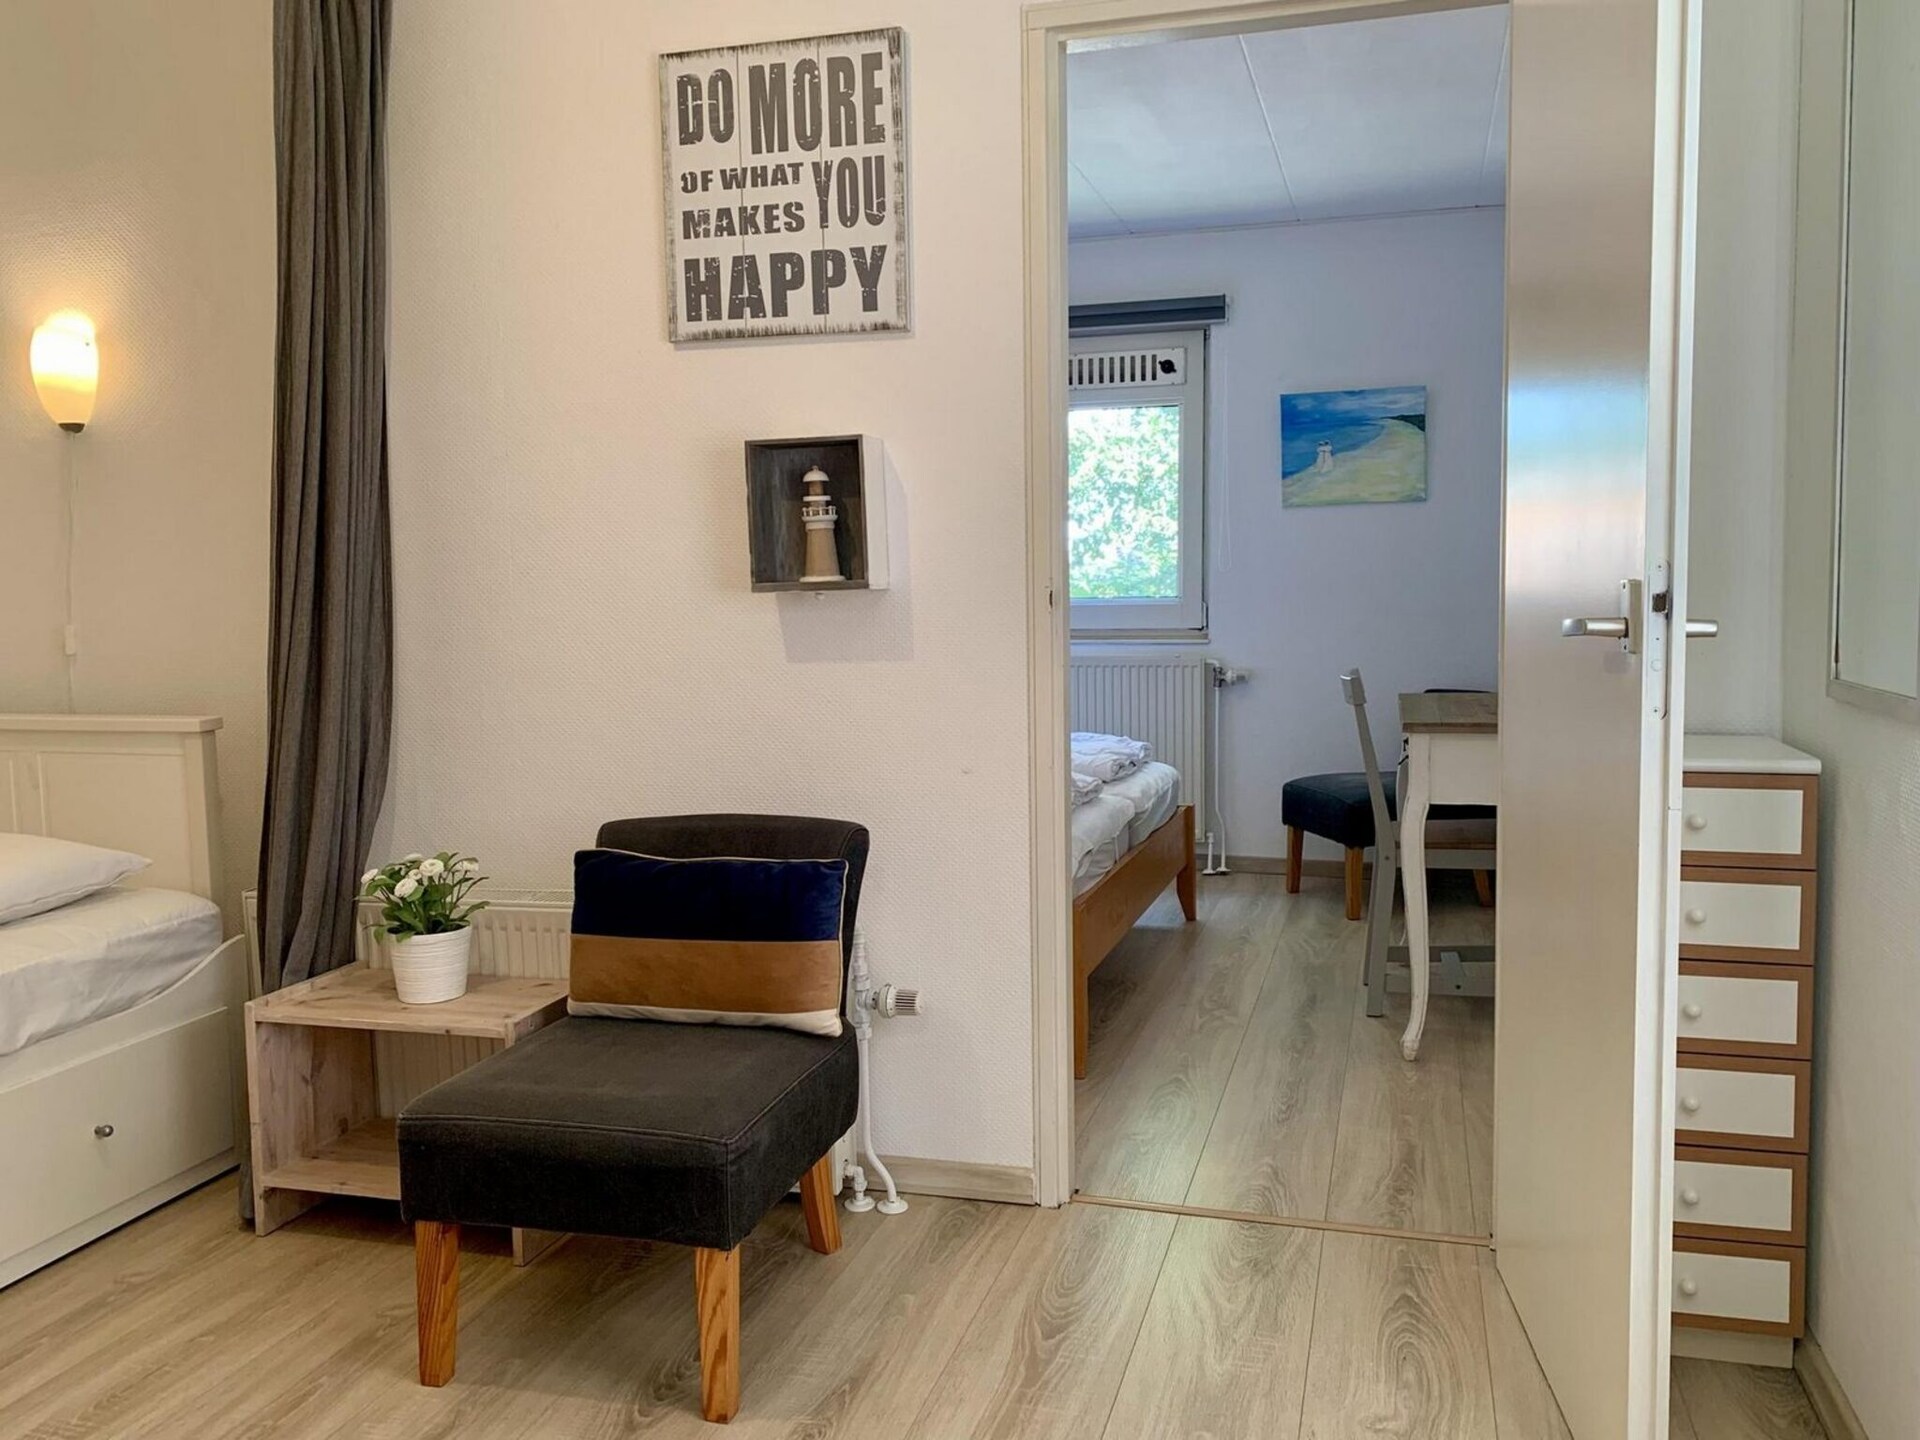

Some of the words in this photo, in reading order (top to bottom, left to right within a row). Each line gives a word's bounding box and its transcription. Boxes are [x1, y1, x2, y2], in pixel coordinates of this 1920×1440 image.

[677, 68, 734, 146] DO
[748, 52, 886, 155] MORE
[680, 170, 713, 194] OF
[719, 162, 804, 190] WHAT
[811, 155, 886, 229] YOU
[682, 201, 805, 240] MAKES
[684, 245, 887, 322] HAPPY
